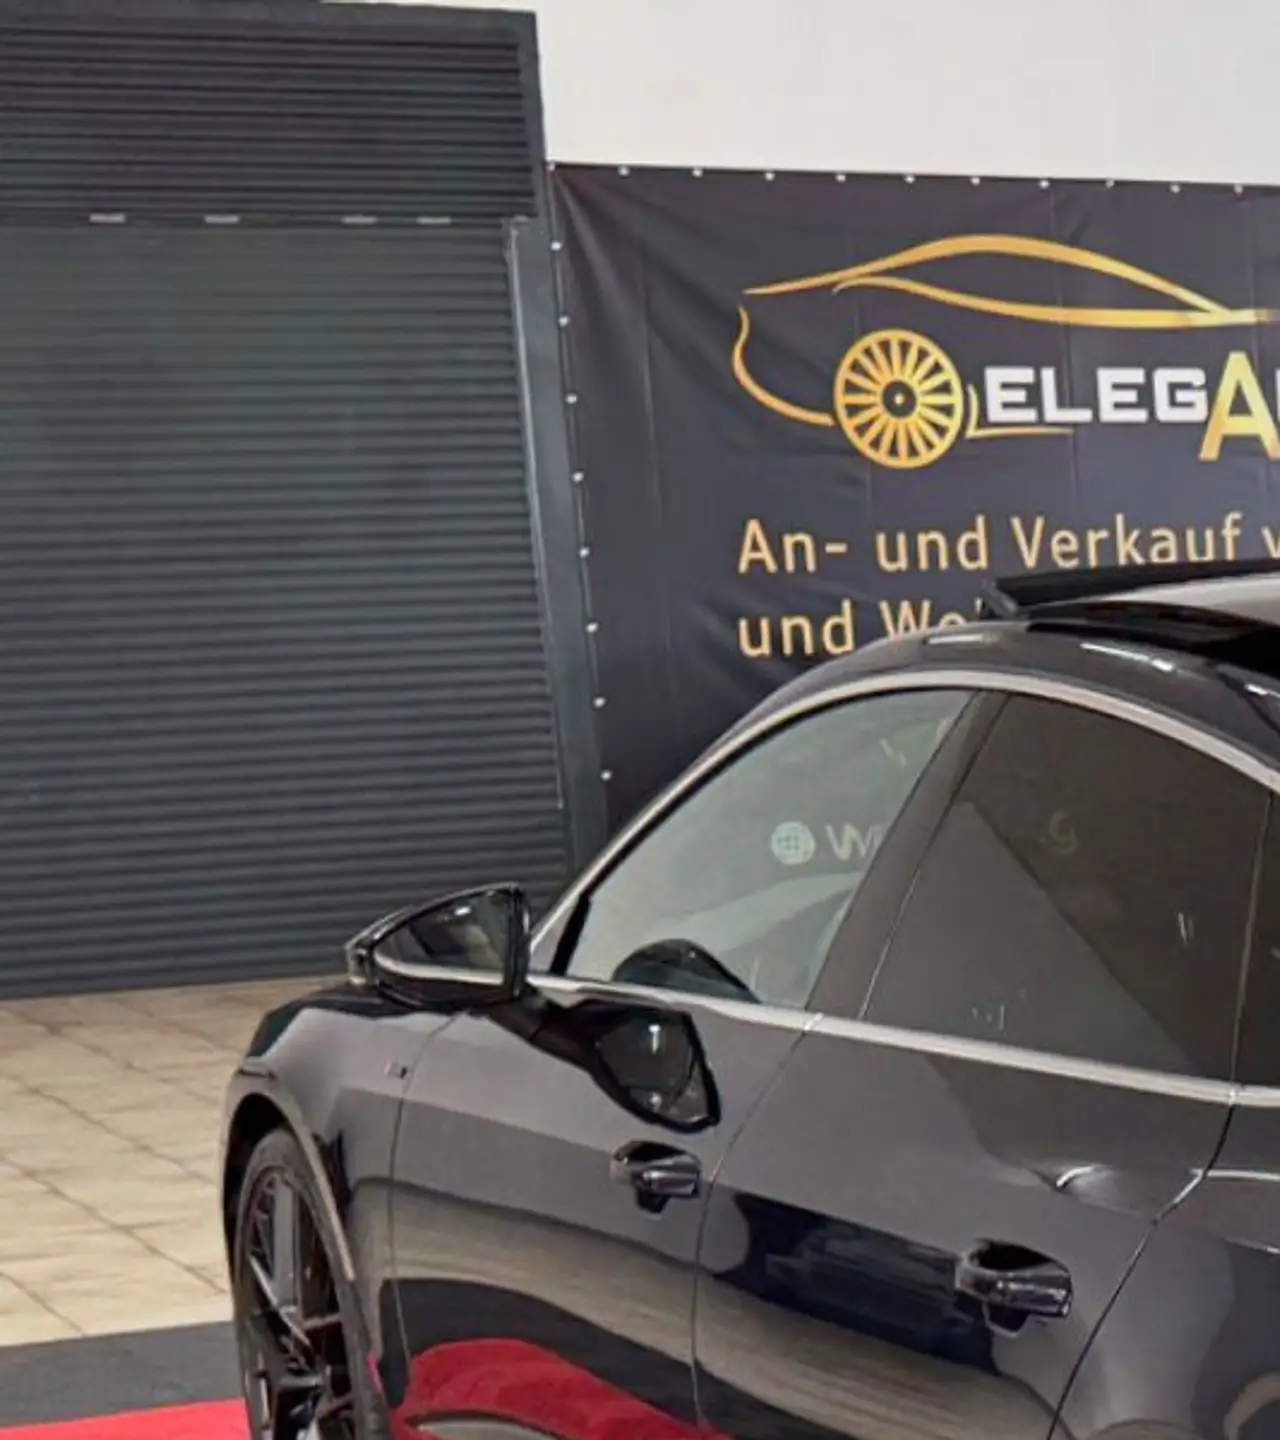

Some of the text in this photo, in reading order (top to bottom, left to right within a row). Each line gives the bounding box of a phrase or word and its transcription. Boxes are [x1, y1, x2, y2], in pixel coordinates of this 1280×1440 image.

[738, 518, 848, 574] An-
[876, 514, 990, 570] und
[1011, 510, 1243, 568] Verkauf
[738, 600, 857, 658] und
